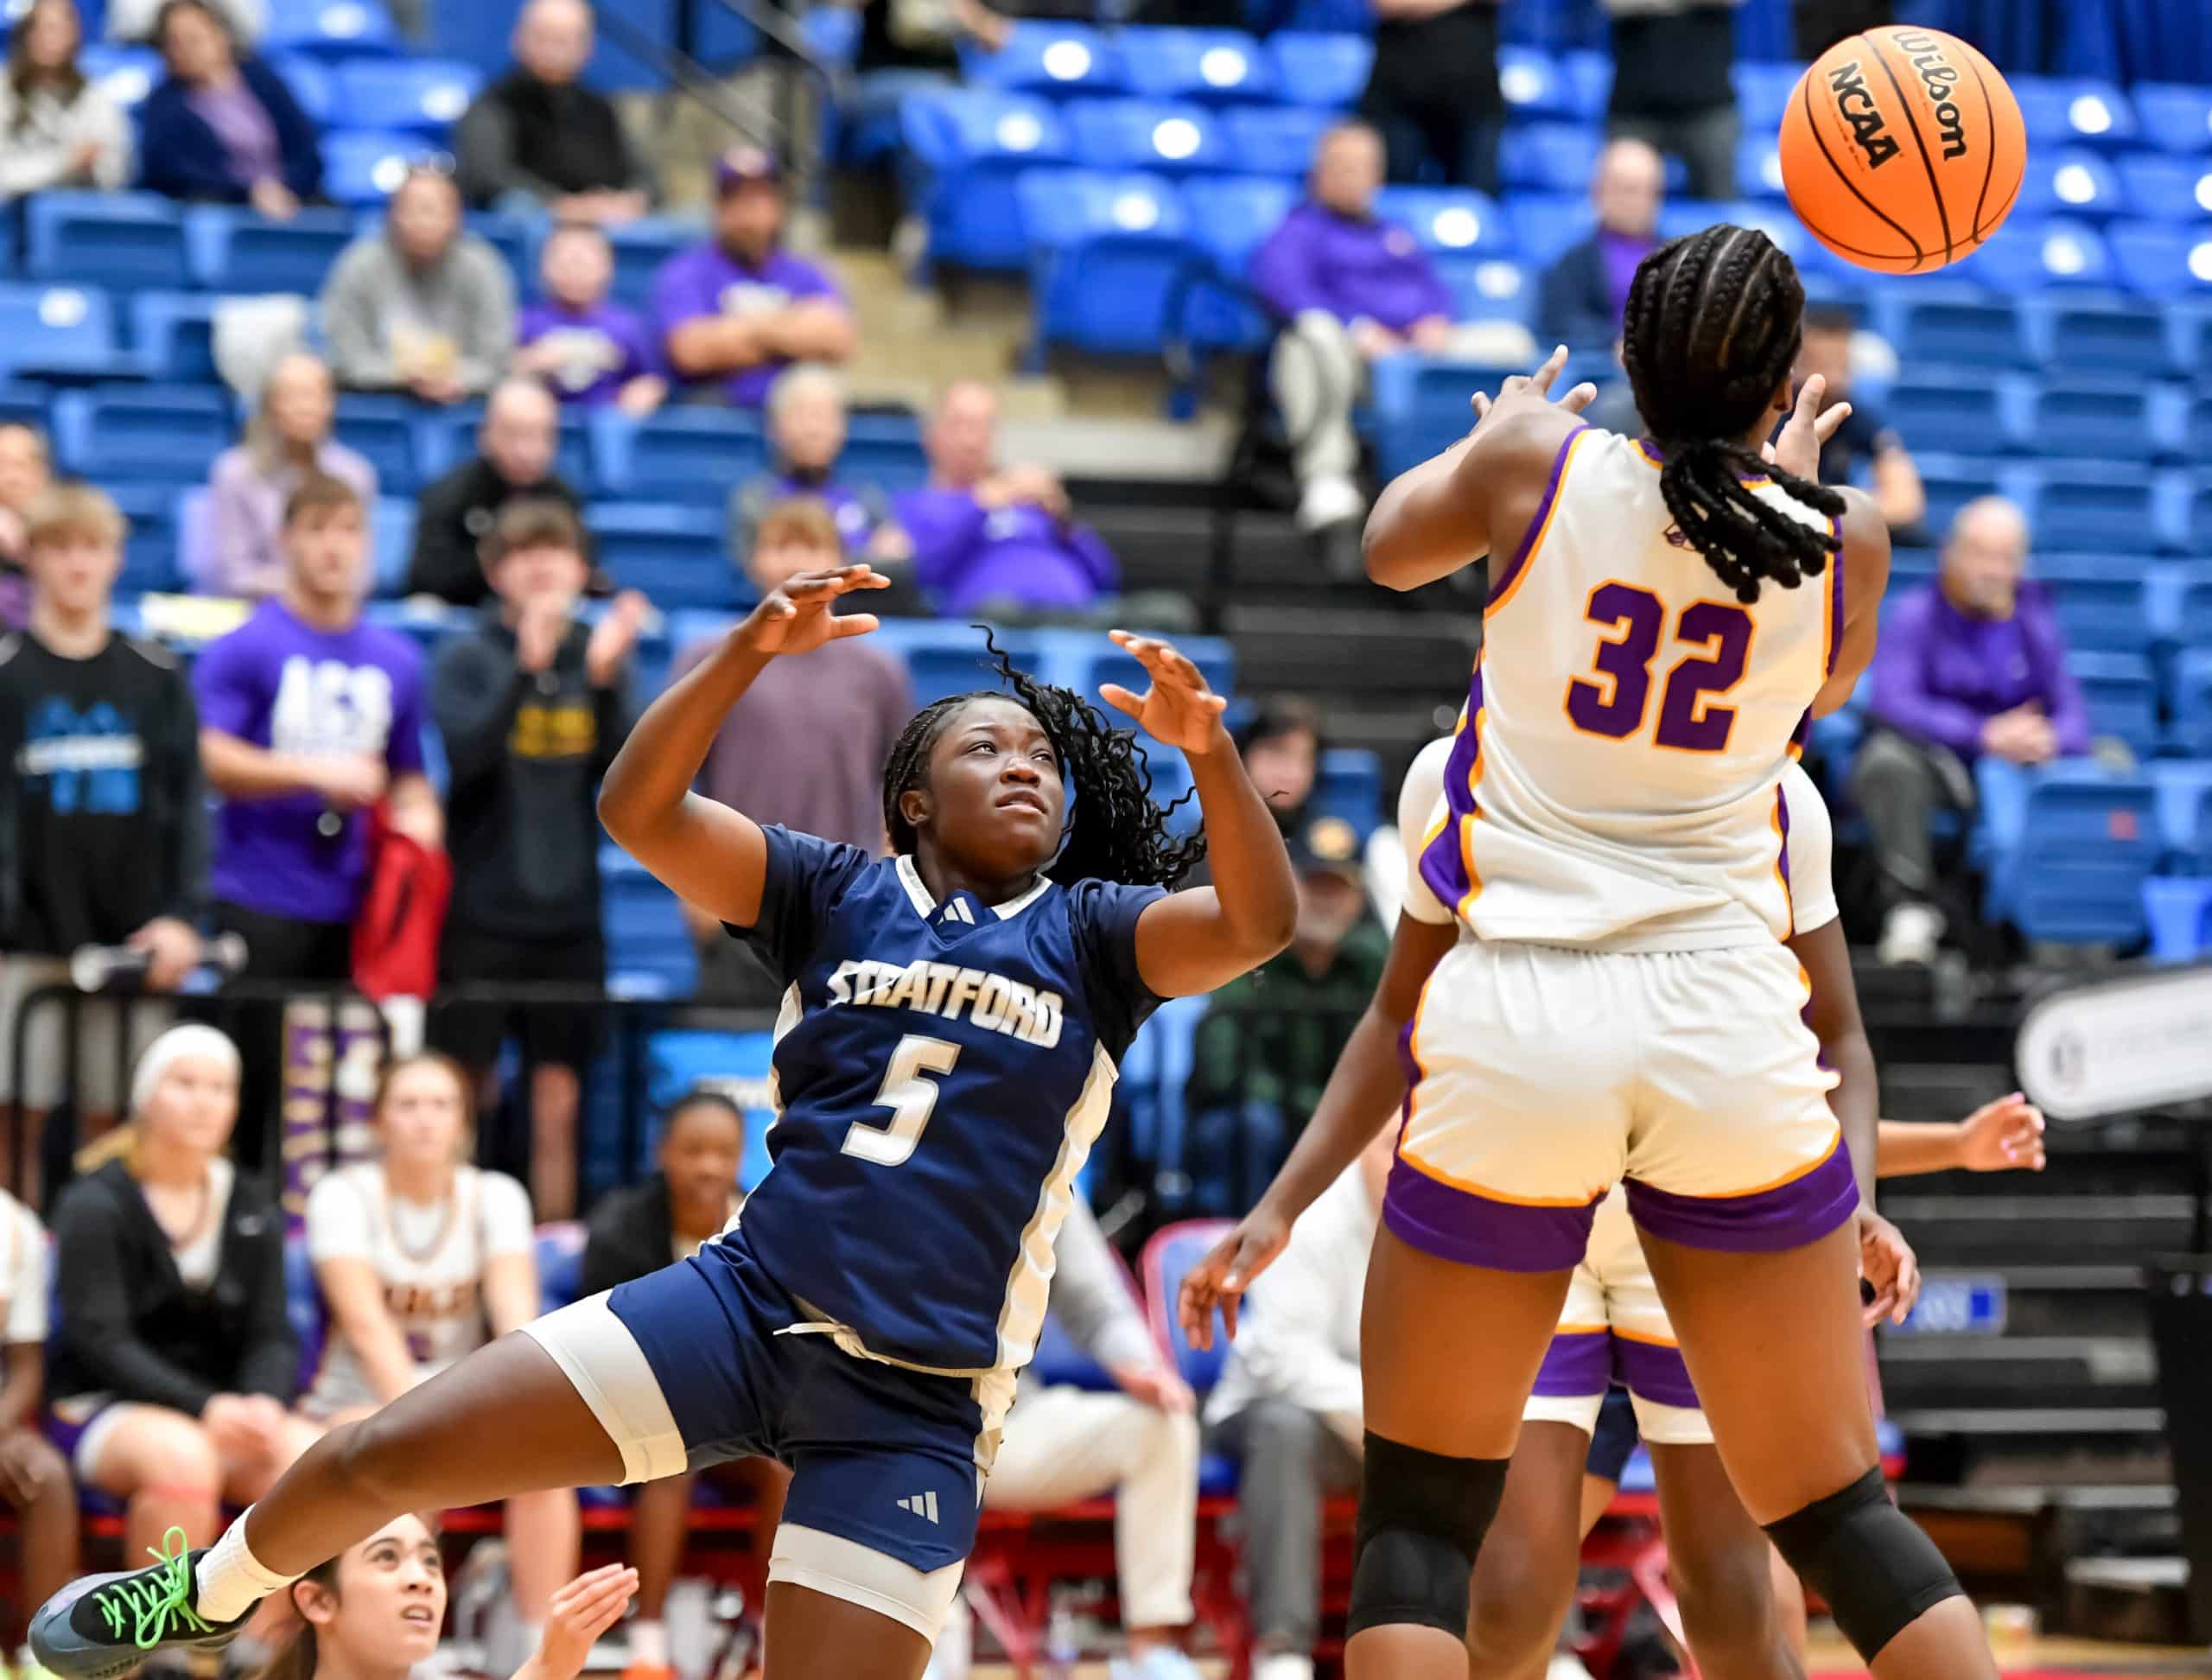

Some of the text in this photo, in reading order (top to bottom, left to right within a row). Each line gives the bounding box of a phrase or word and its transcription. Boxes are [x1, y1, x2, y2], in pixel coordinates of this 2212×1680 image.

[1828, 61, 1901, 169] NCAA
[1892, 31, 1967, 162] Wilson
[1562, 577, 1757, 755] 32
[827, 959, 1064, 1049] STRATFORD
[839, 1034, 962, 1167] 5
